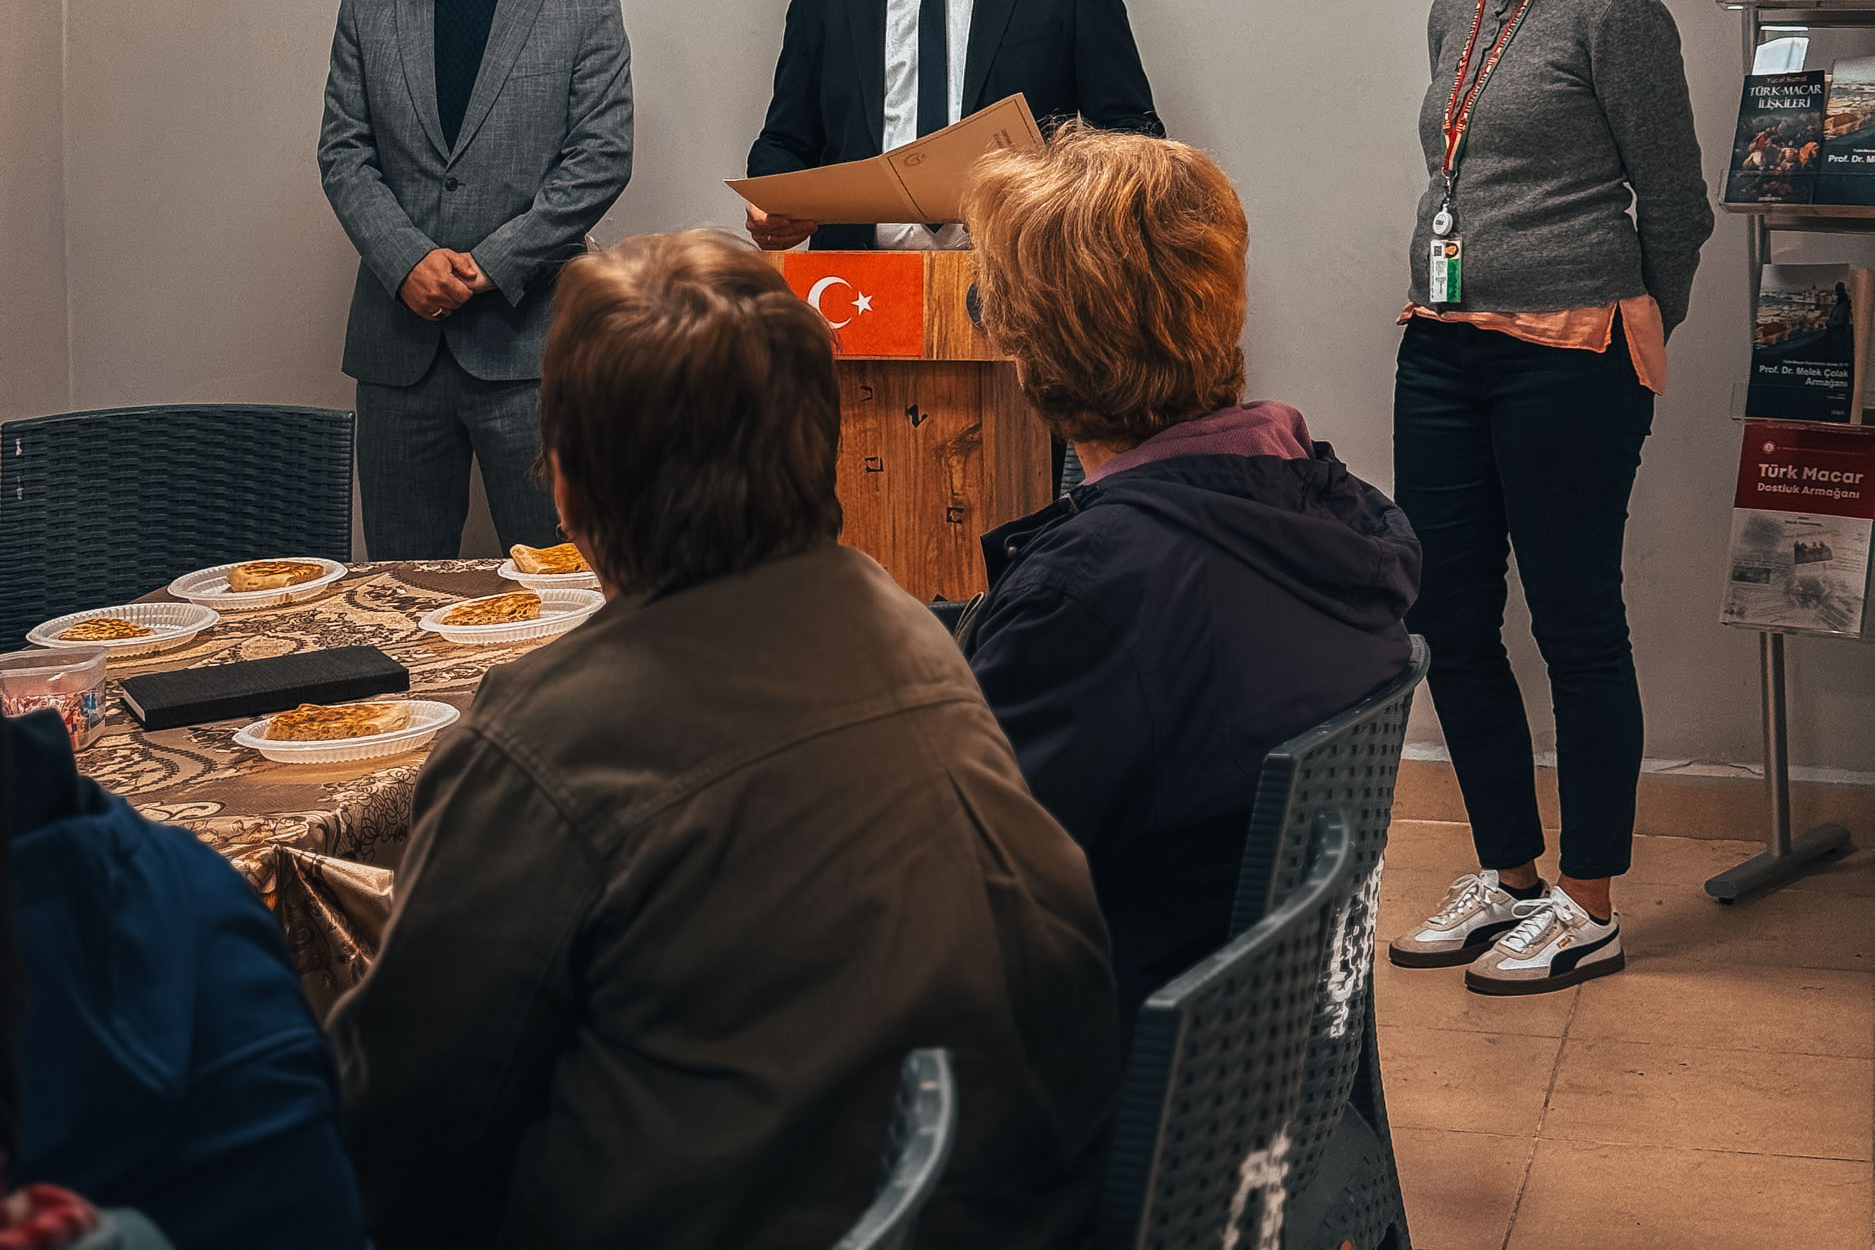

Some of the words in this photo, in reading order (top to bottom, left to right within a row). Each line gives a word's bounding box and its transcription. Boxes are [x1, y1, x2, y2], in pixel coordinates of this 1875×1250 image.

[1750, 84, 1823, 97] TÜRK-MACAR
[1828, 154, 1850, 163] Prof.
[1851, 155, 1865, 163] Dr.
[1759, 365, 1779, 374] Prof.
[1781, 366, 1794, 375] Dr.
[1796, 367, 1822, 376] Melek
[1824, 369, 1849, 379] Çolak
[1759, 463, 1799, 479] Türk
[1802, 466, 1864, 484] Macar
[1801, 485, 1860, 500] Armağanı
